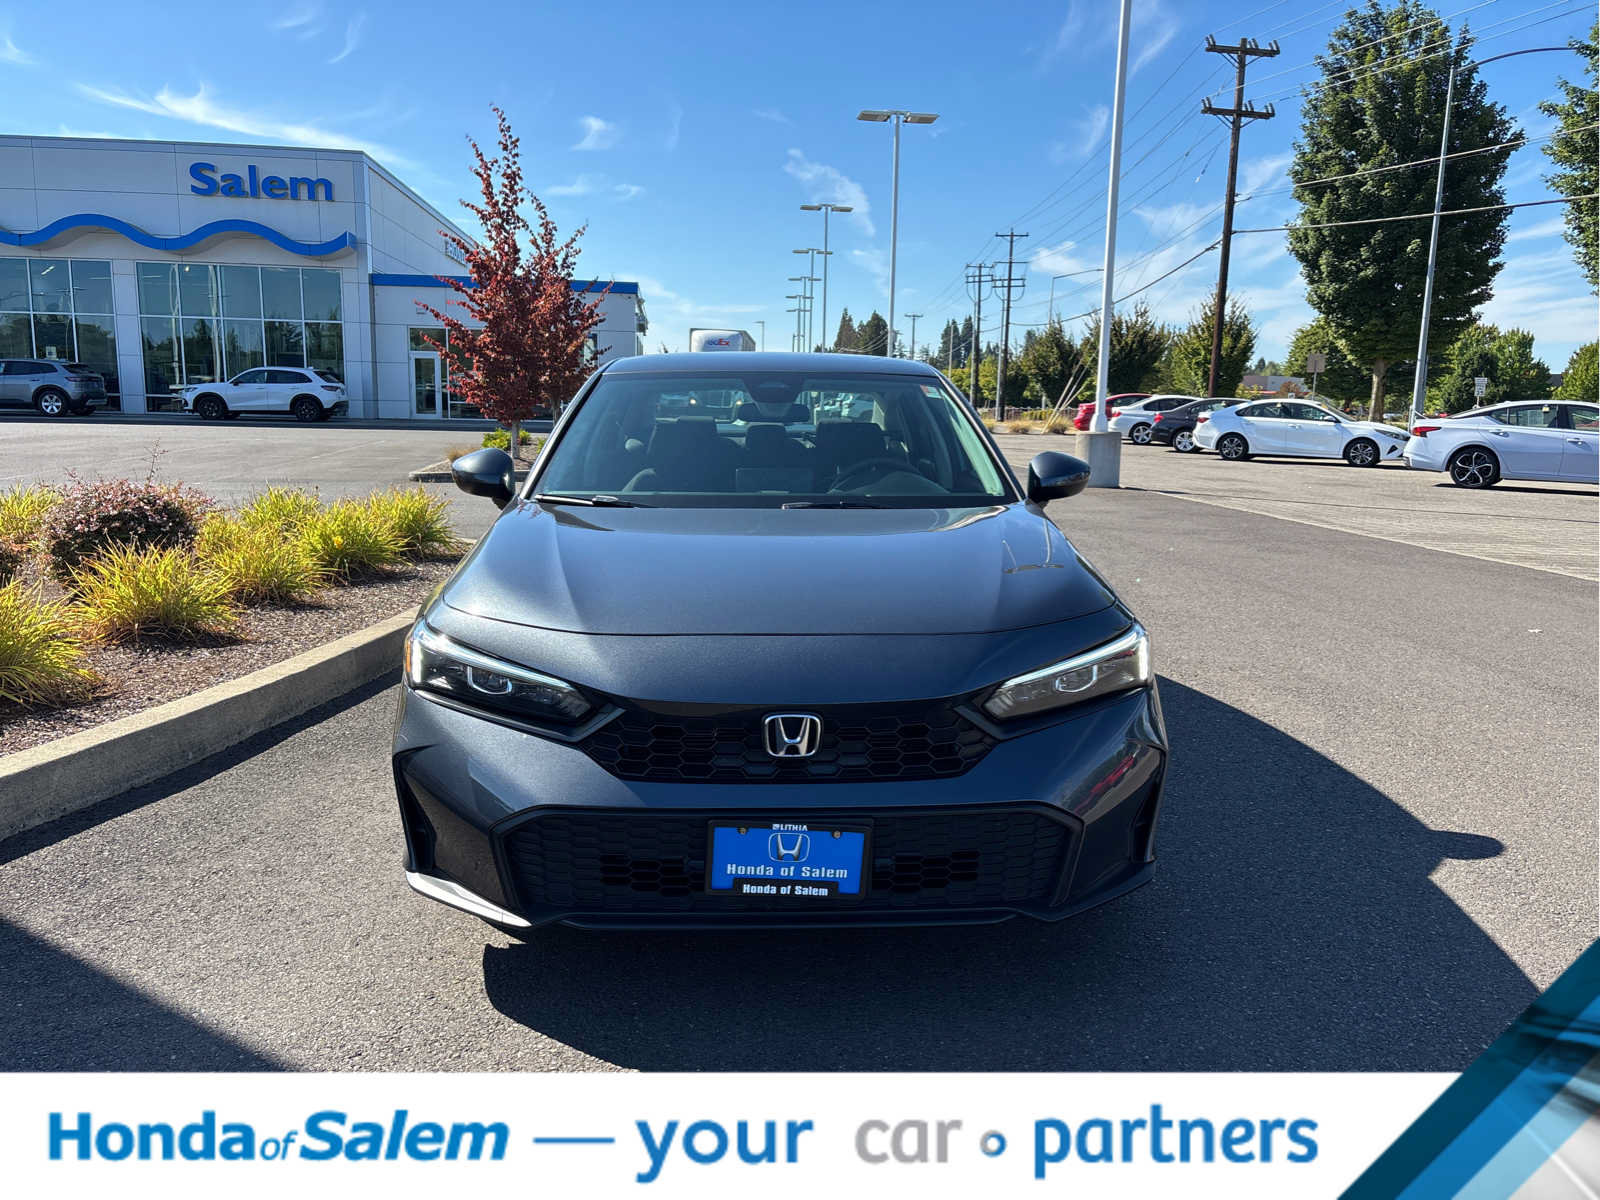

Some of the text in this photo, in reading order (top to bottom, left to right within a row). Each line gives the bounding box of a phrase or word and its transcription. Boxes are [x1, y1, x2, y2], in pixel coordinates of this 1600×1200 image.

[189, 162, 334, 201] Salem
[780, 823, 808, 831] LITHIA
[727, 863, 848, 879] Honda of Salem
[742, 884, 829, 896] Honda of Salem
